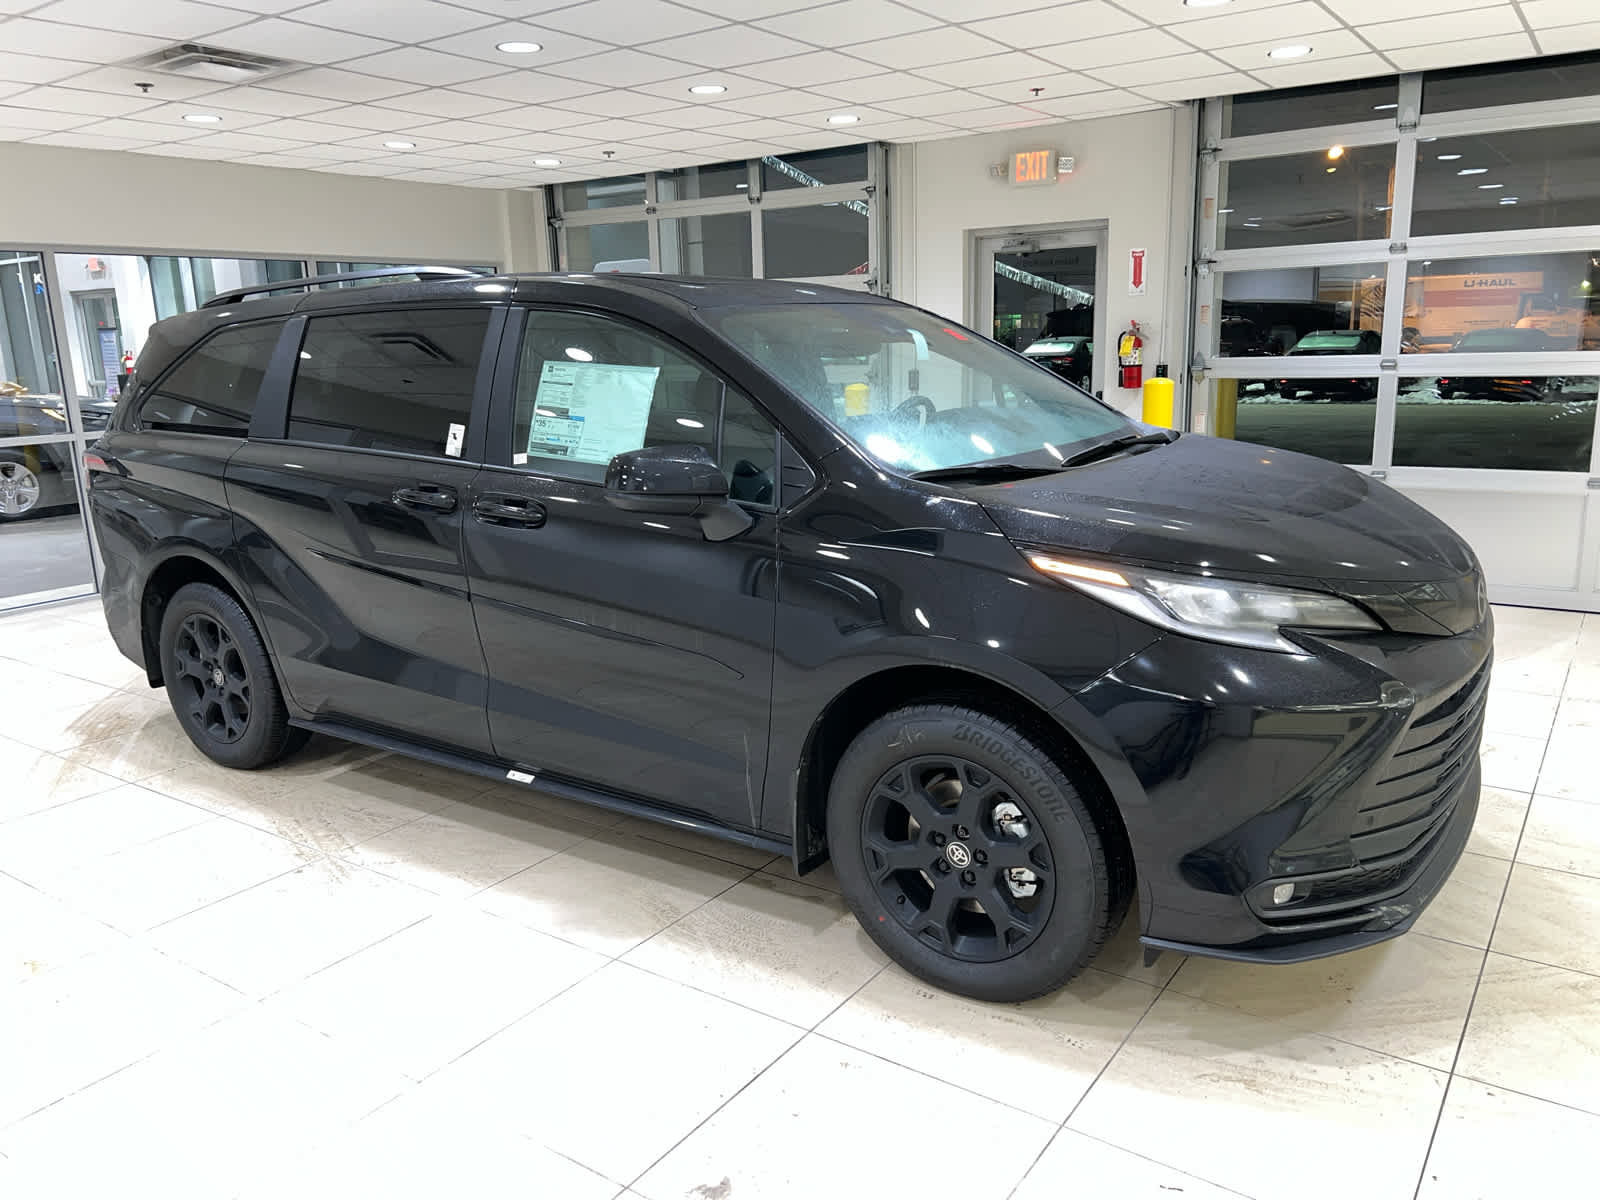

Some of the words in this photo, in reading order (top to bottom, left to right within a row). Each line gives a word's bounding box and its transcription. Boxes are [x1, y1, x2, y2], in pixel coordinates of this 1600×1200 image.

[1015, 150, 1049, 182] EXIT
[1463, 278, 1516, 288] U-HAUL
[952, 723, 1070, 824] BRIDGESTONE
